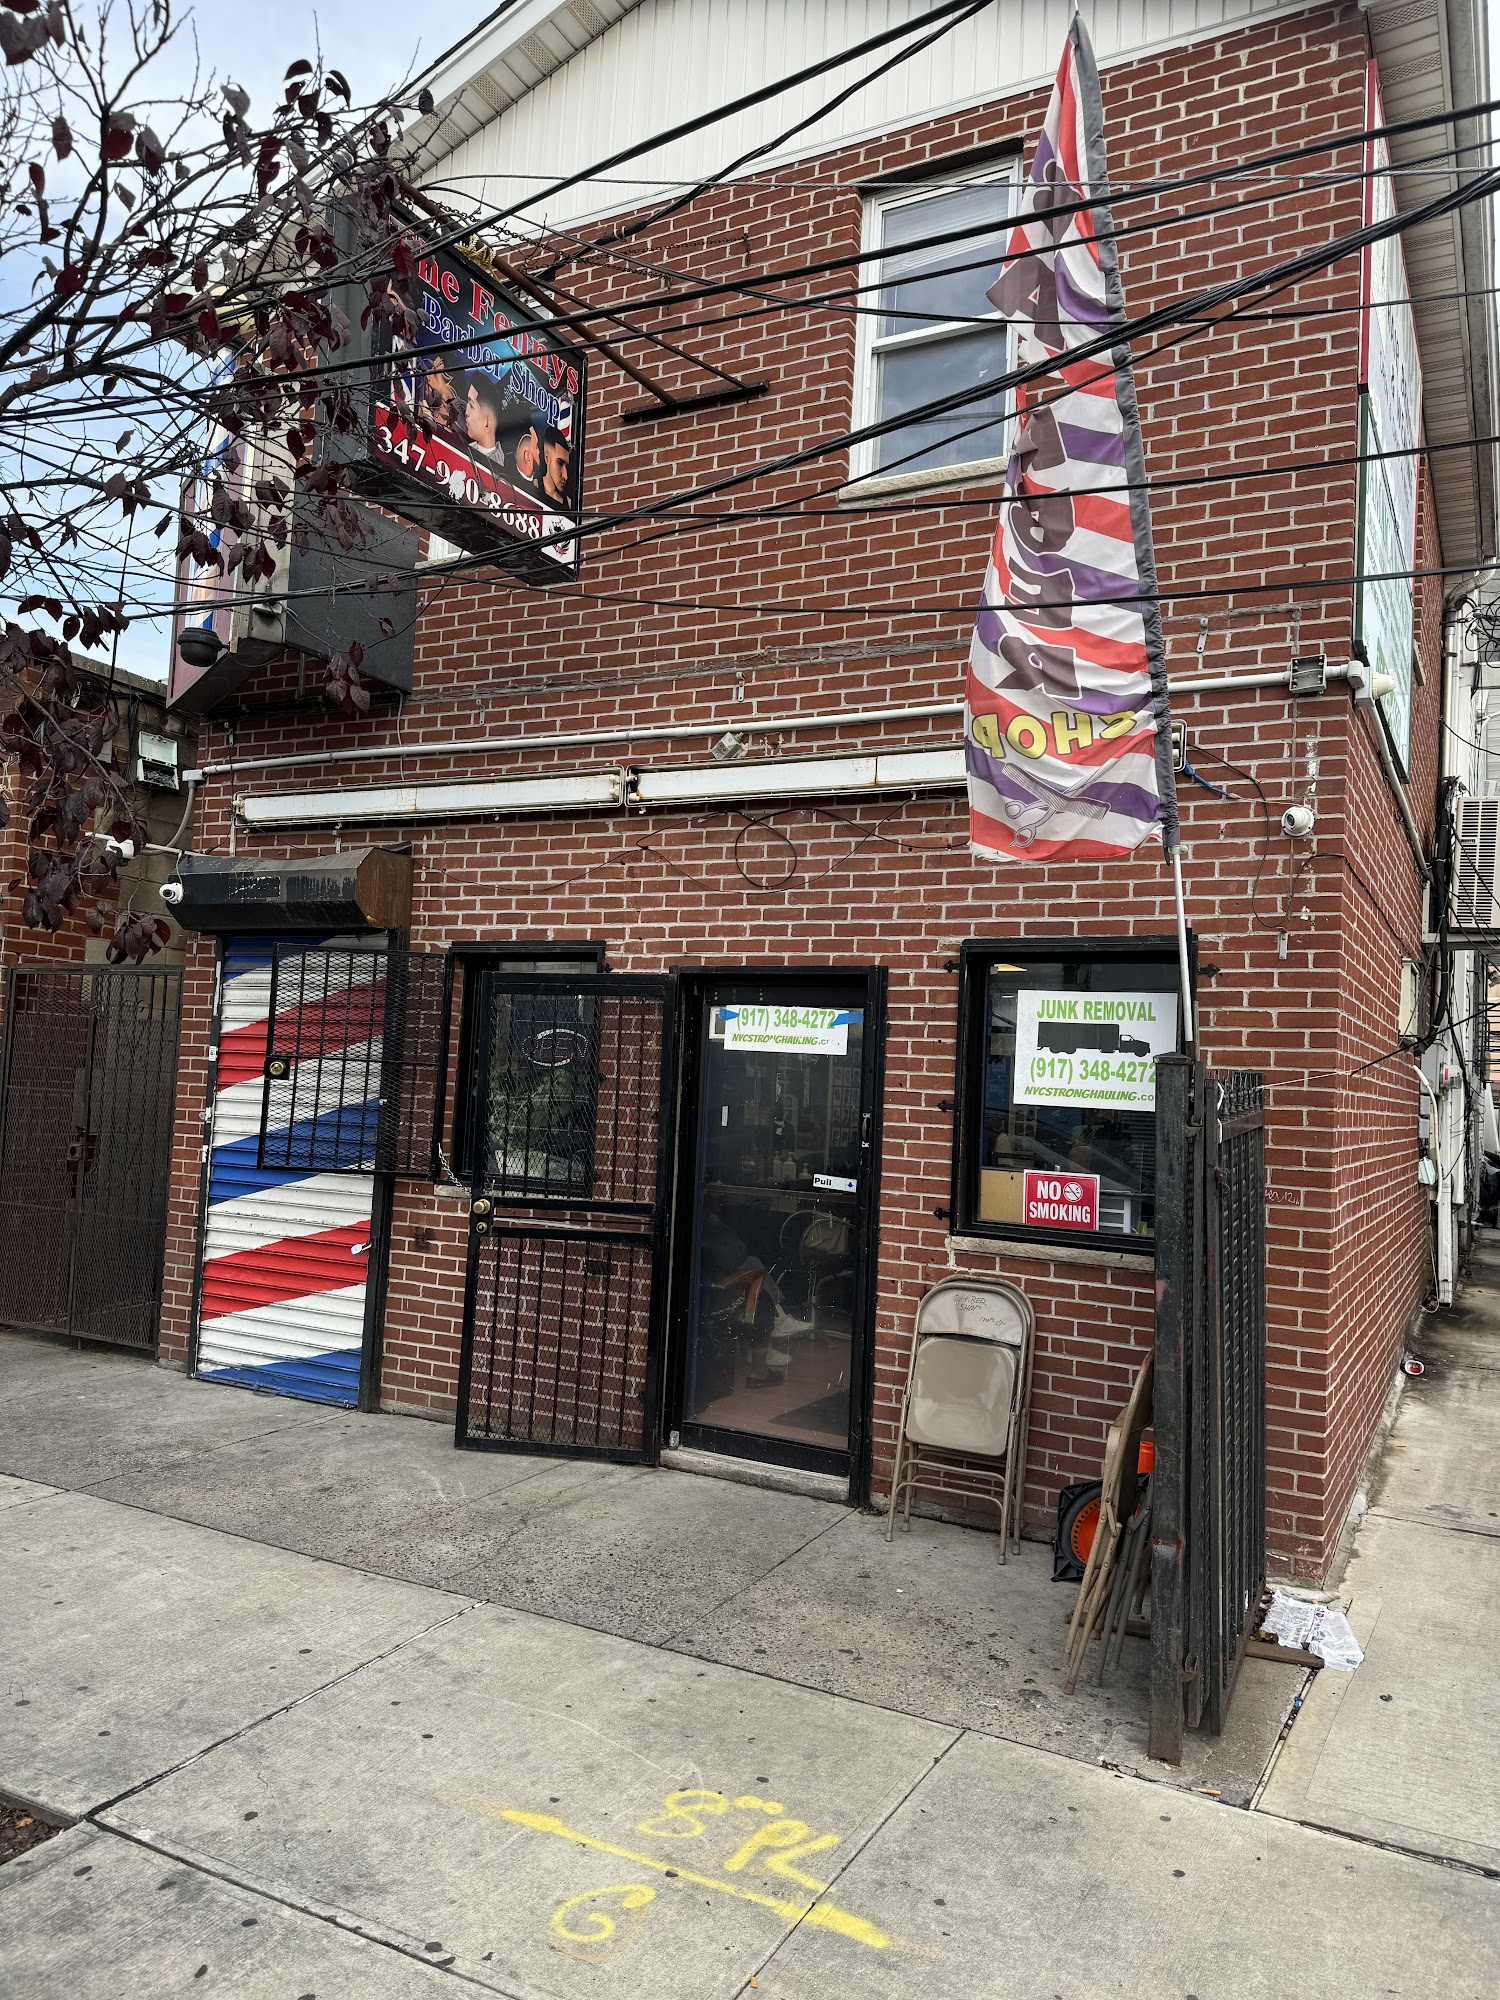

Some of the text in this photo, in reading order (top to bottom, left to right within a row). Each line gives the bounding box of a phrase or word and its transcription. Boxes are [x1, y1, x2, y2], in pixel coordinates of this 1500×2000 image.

[423, 291, 561, 427] Barber Shop
[376, 425, 541, 540] 347-90-8688
[736, 1007, 836, 1032] (917) 348-4272
[1037, 999, 1157, 1022] JUNK REMOVAL
[732, 1033, 840, 1046] NYCSTRONGHAULING.c
[1030, 1056, 1157, 1085] (917) 348-4272
[1024, 1085, 1155, 1102] NYCSTRONGHAULING.co
[814, 1176, 832, 1186] Pull
[1036, 1180, 1062, 1201] NO
[1029, 1201, 1091, 1224] SMOKING
